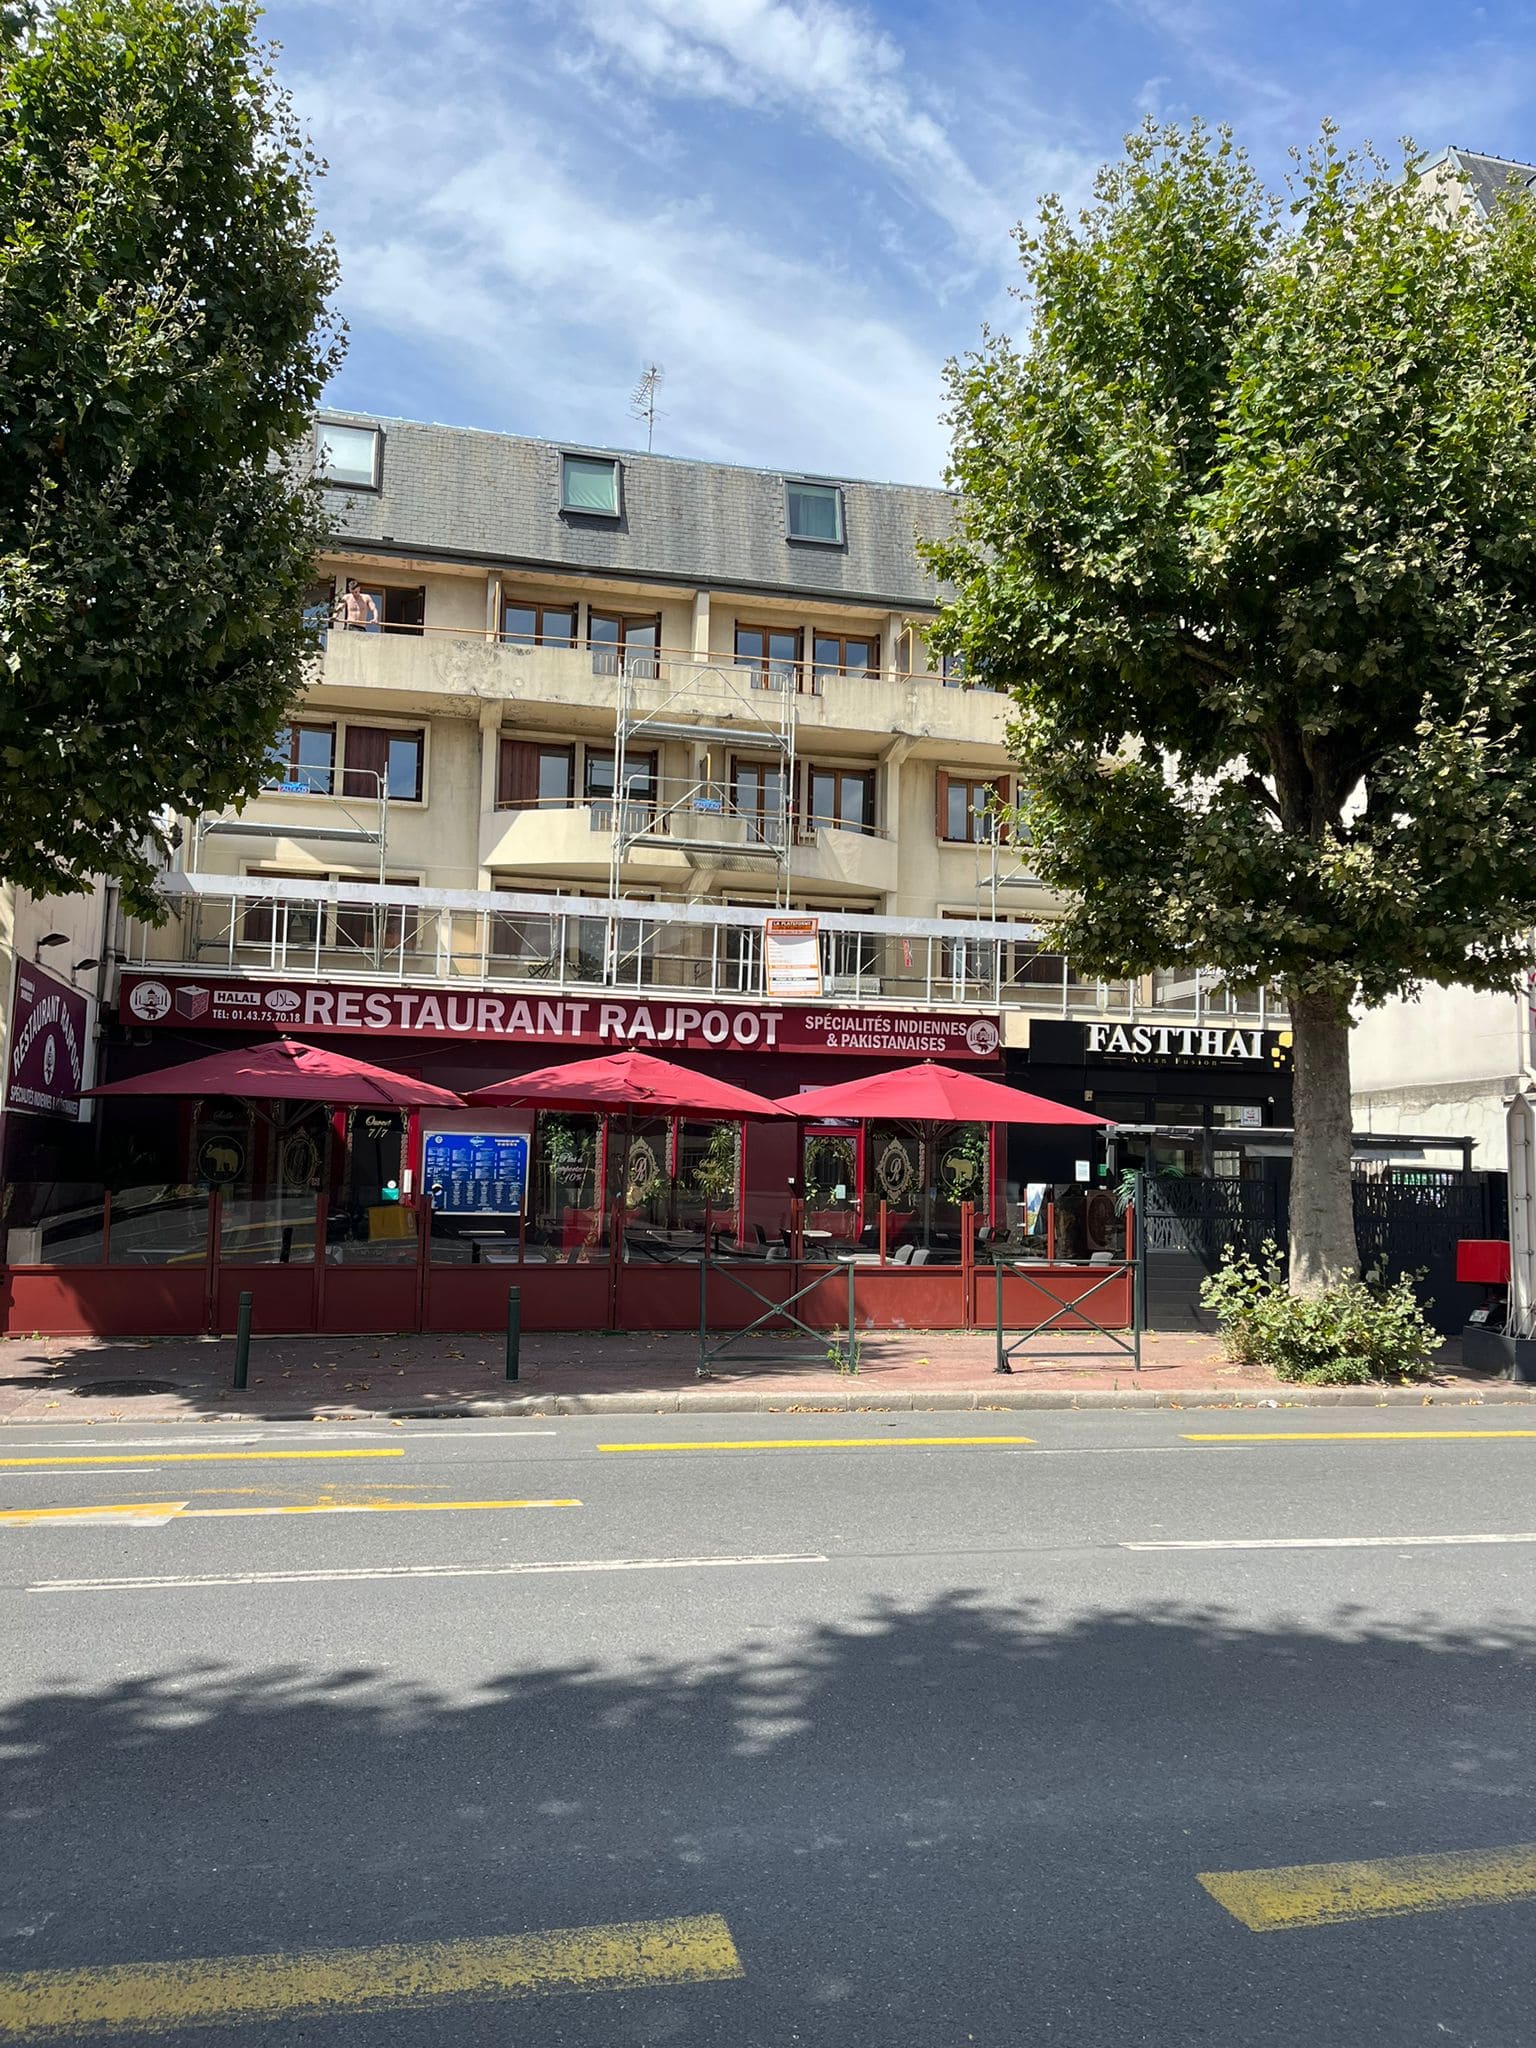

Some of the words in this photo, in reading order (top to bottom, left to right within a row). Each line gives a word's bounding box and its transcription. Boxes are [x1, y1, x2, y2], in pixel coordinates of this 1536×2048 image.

[217, 991, 258, 1003] HALAL
[269, 991, 297, 1009] حلال
[231, 1010, 301, 1024] 01.43.75.70.18
[304, 989, 589, 1036] RESTAURANT
[599, 1004, 783, 1045] RAJPOOT
[805, 1011, 891, 1033] SPÉCIALITÉS
[894, 1018, 968, 1036] INDIENNES
[13, 995, 60, 1076] RESTAURANT
[826, 1034, 838, 1048] &
[841, 1035, 946, 1052] PAKISTANAISES
[1131, 1055, 1167, 1065] Asian
[1174, 1057, 1218, 1066] Fusion
[368, 1127, 389, 1140] 7/7
